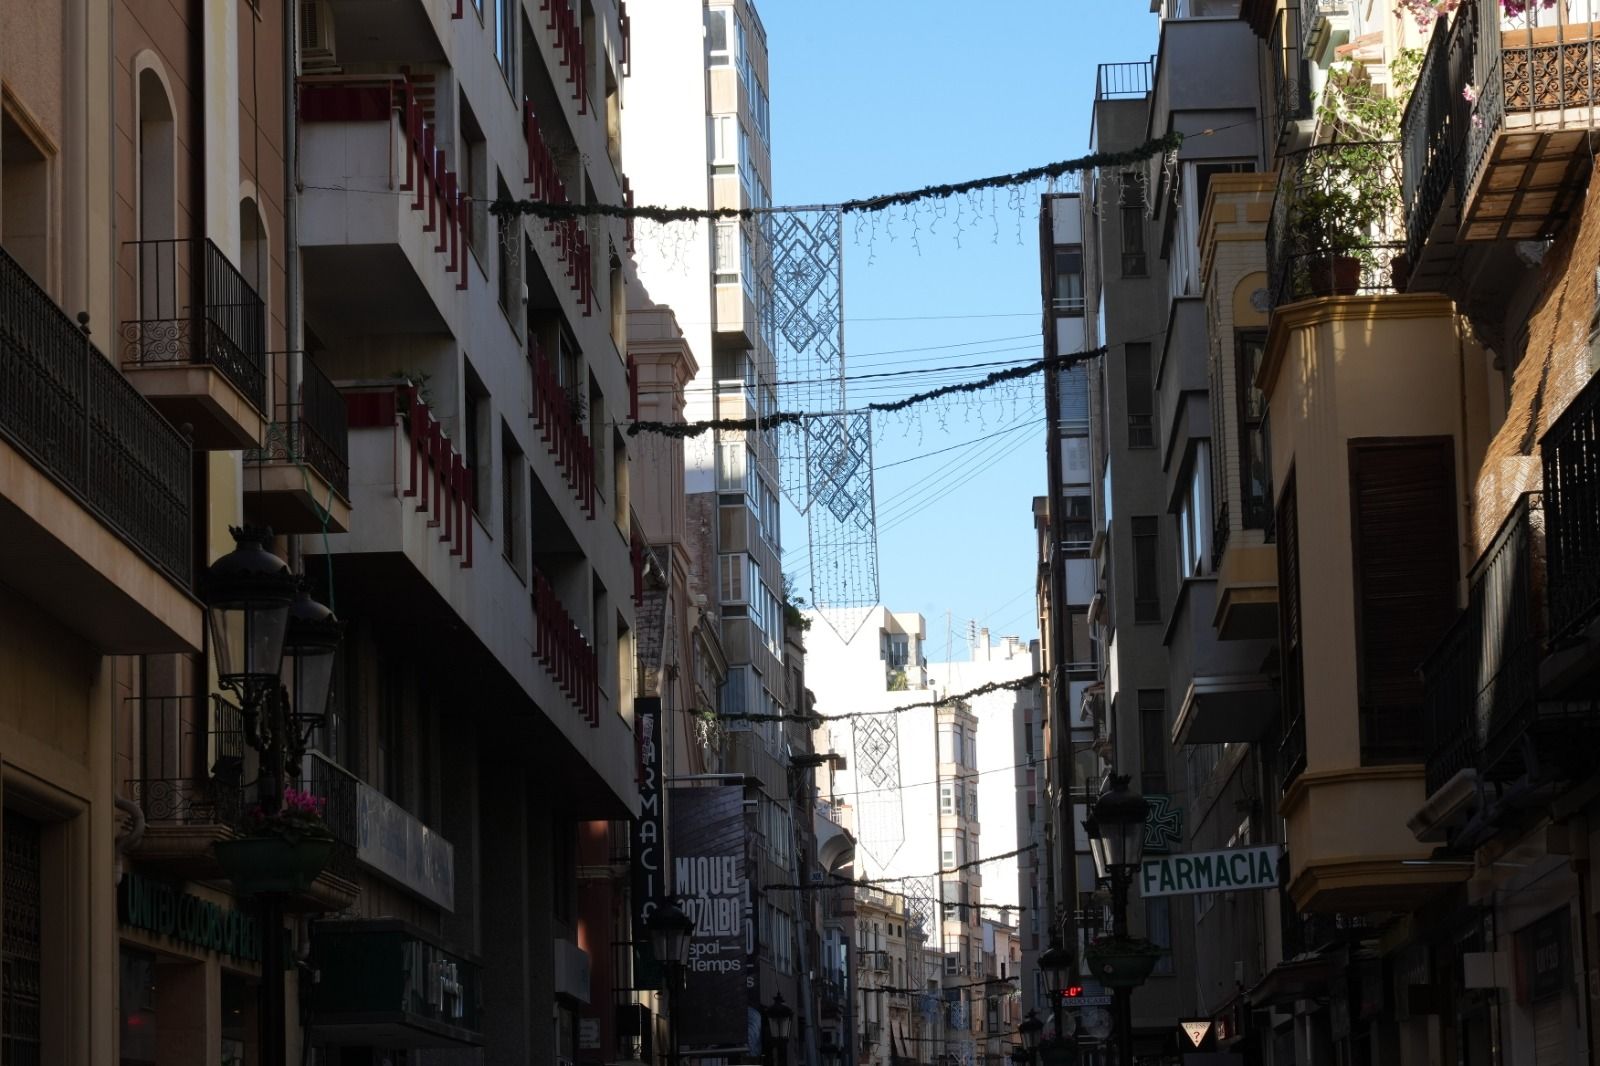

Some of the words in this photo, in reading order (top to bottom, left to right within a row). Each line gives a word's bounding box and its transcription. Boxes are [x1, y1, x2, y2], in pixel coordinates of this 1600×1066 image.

[639, 713, 658, 925] ARMACIA
[676, 856, 739, 897] MIQUEL
[1143, 851, 1275, 893] FARMACIA
[128, 872, 176, 935] UNITED
[177, 895, 222, 952] COLORS
[224, 906, 240, 956] OF
[677, 897, 740, 937] OZALBO
